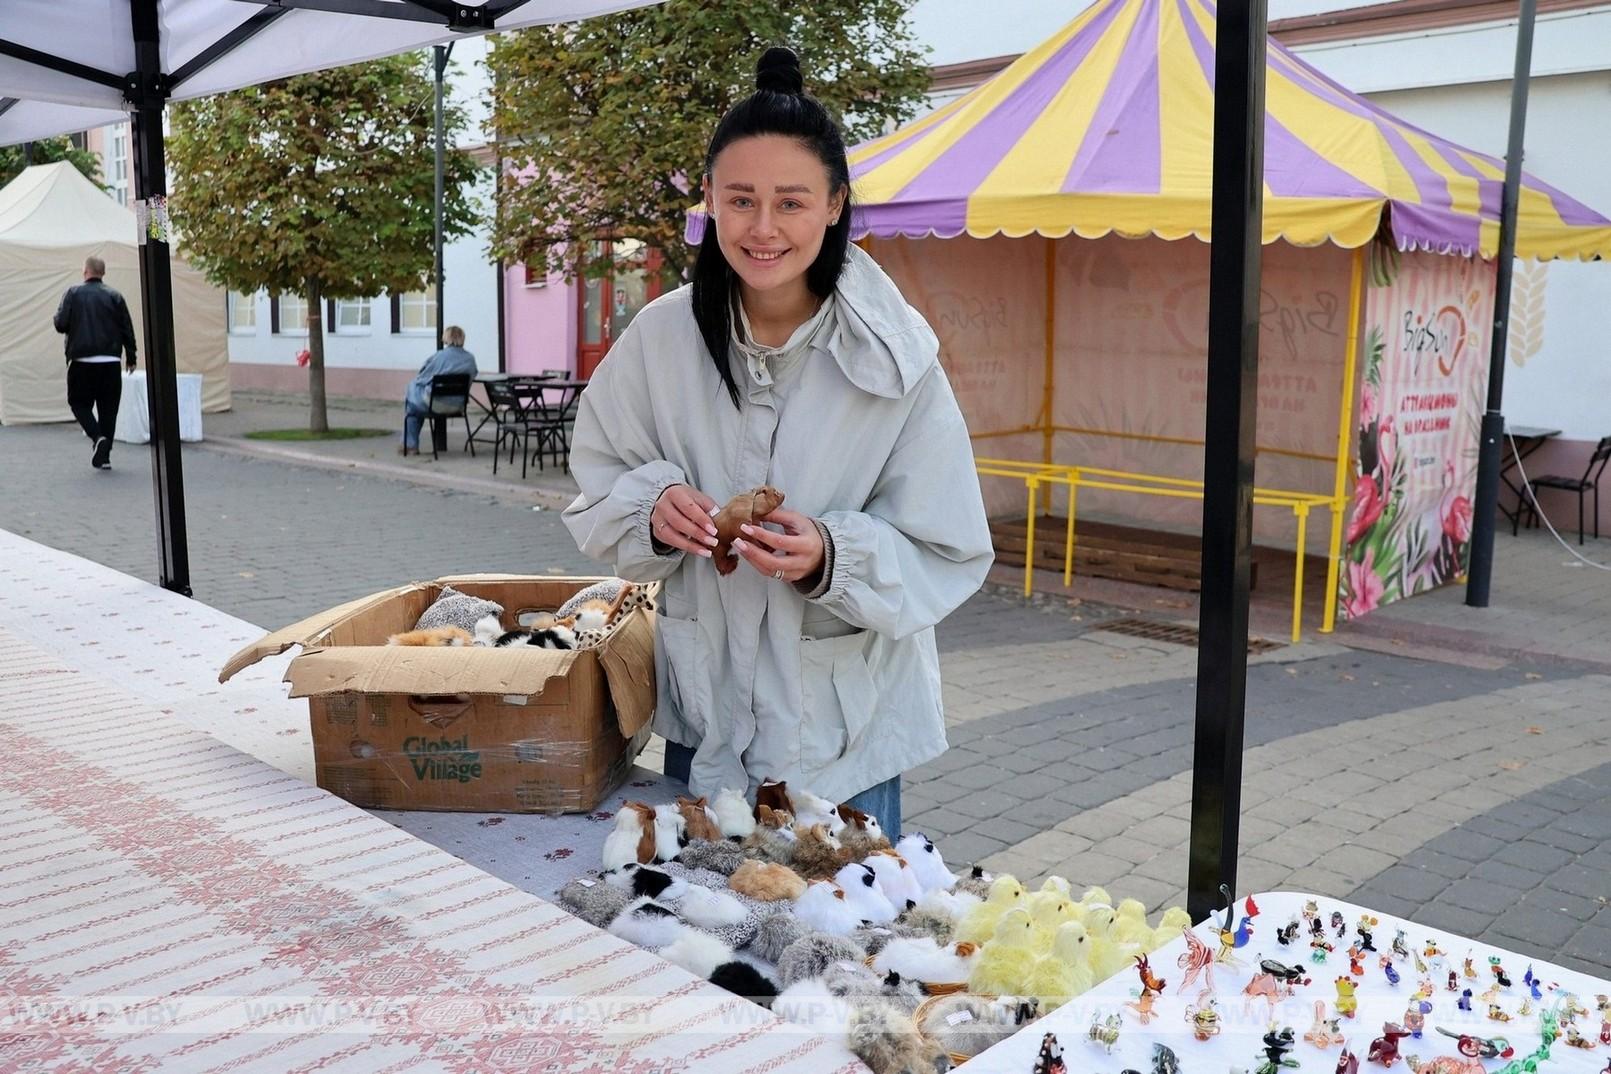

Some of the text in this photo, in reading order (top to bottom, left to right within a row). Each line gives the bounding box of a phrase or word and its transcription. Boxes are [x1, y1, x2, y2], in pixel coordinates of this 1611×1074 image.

[1403, 310, 1450, 377] BigSun
[403, 735, 469, 758] Global
[409, 758, 482, 783] Village
